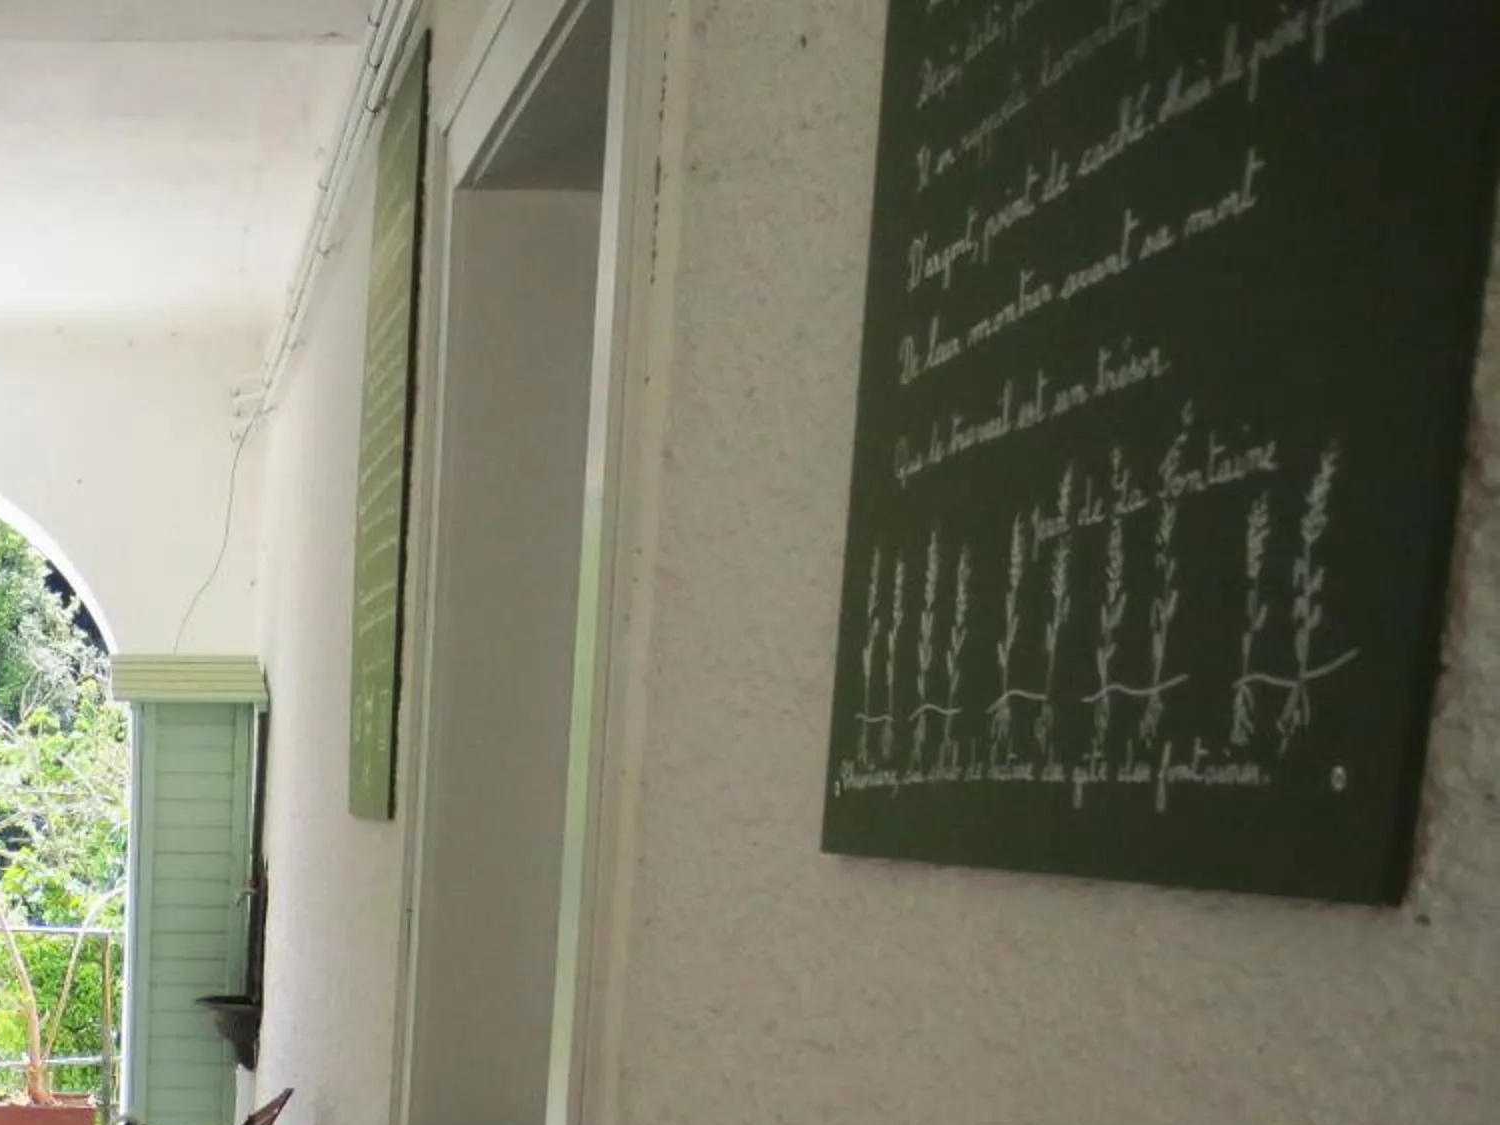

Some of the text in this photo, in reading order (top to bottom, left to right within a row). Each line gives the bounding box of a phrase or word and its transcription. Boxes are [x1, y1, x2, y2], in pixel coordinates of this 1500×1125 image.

[1041, 148, 1070, 204] de
[1059, 207, 1142, 301] avant
[1183, 146, 1267, 238] mort
[1077, 476, 1106, 526] de
